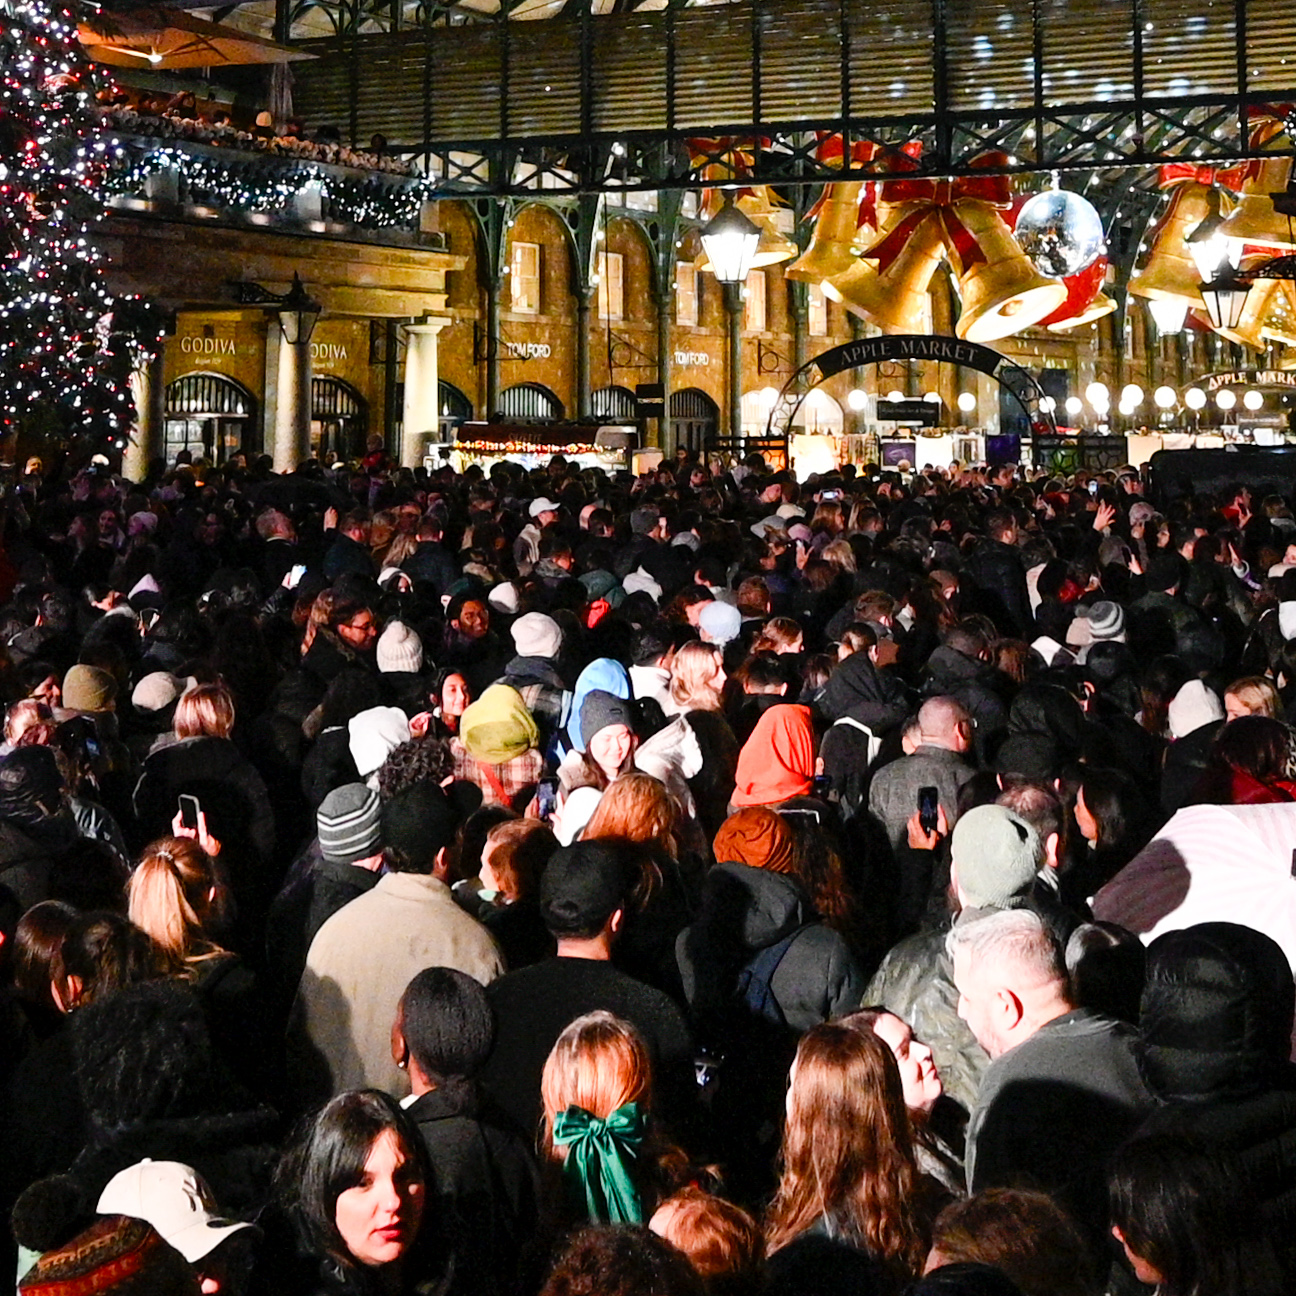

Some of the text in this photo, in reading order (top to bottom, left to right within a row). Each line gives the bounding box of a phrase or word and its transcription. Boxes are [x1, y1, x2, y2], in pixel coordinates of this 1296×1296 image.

[180, 336, 236, 355] GODIVA
[310, 343, 347, 359] ODIVA
[506, 342, 551, 358] TOM FORD
[840, 340, 978, 366] APPLE MARKET
[674, 351, 709, 365] TOM FORD
[1208, 371, 1247, 390] APPLE
